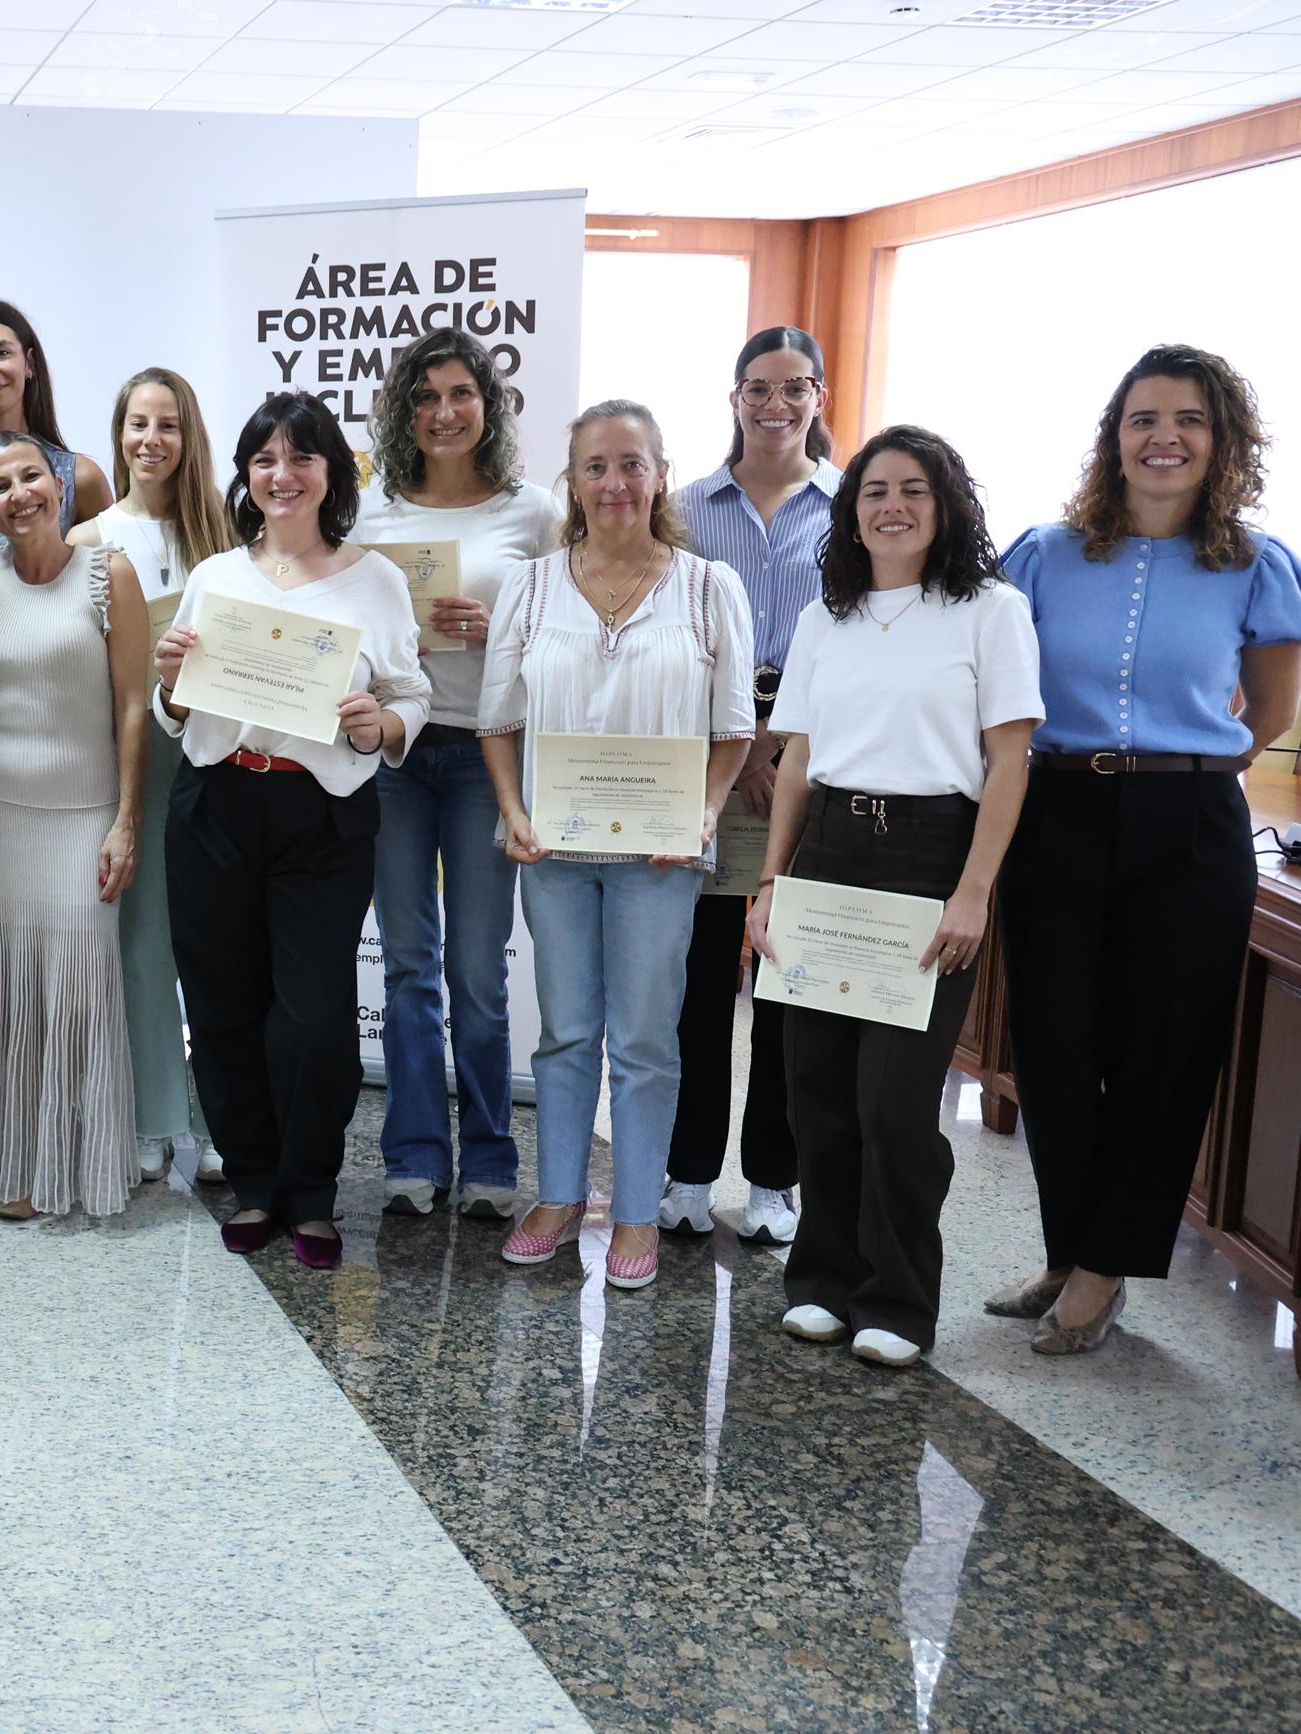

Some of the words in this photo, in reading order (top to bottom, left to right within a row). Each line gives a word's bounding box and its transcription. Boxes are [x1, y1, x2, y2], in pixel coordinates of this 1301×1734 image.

[295, 253, 420, 300] ÁREA
[434, 257, 497, 294] DE
[257, 298, 536, 343] FORMACIÓN
[272, 350, 302, 383] Y
[222, 667, 254, 681] SERRANO
[254, 675, 284, 690] ESTEVAN
[284, 682, 304, 694] PILAR
[596, 775, 619, 783] MARÍA
[798, 924, 821, 934] MARÍA
[822, 927, 838, 937] JOSÉ
[840, 931, 882, 944] FERNÁNDEZ
[882, 938, 910, 949] GARCÍA
